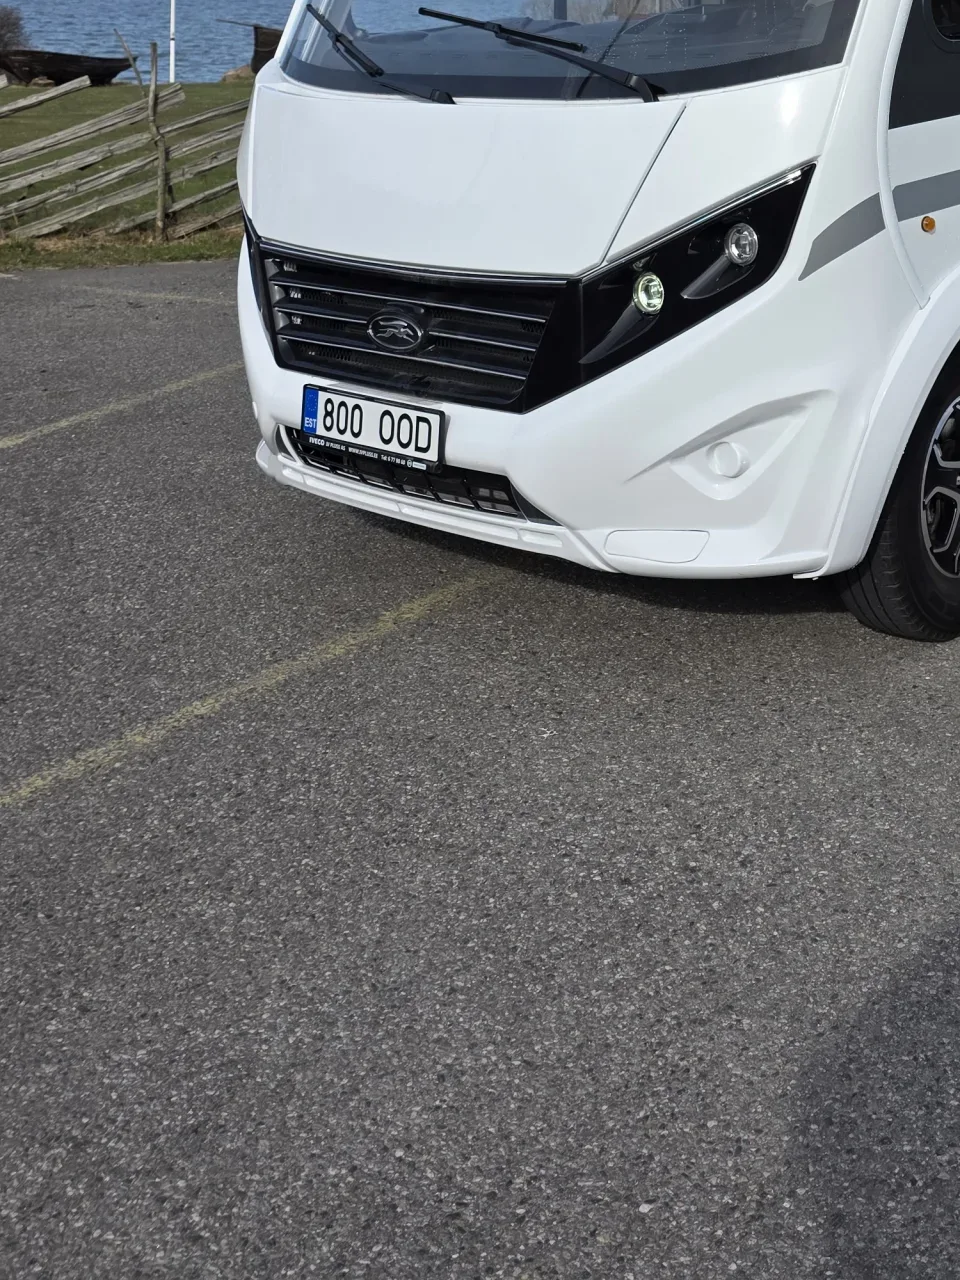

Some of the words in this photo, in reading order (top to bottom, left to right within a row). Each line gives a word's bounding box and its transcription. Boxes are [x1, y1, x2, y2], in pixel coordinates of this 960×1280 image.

[304, 417, 317, 428] EST
[323, 398, 363, 438] 800
[379, 410, 432, 453] OOD
[308, 436, 325, 446] IVECO
